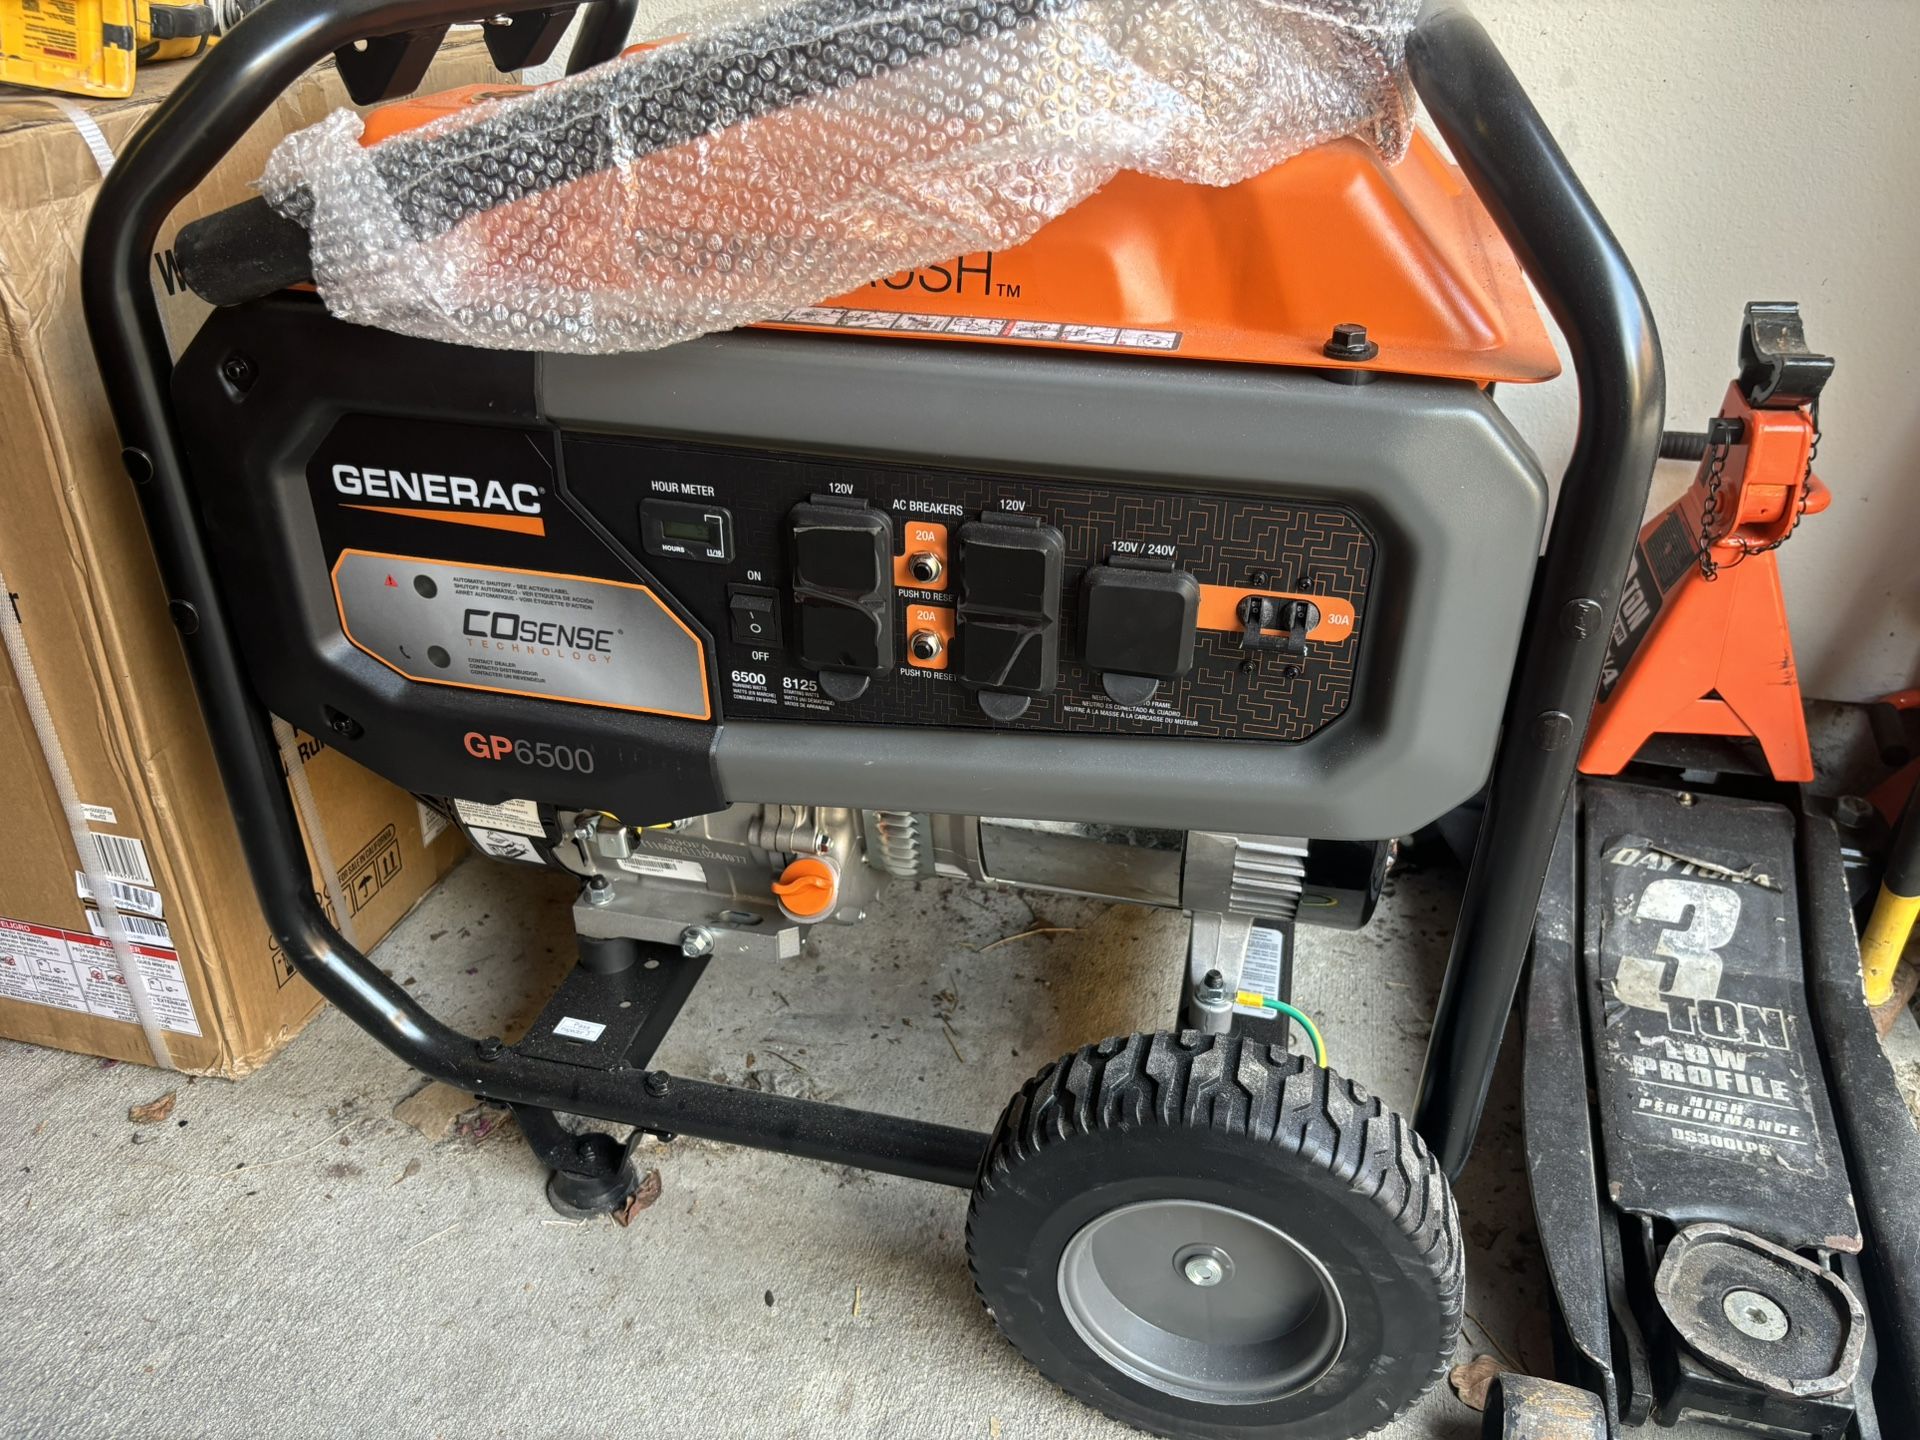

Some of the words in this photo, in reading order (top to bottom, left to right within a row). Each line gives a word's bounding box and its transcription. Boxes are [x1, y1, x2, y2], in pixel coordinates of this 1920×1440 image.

[651, 480, 679, 493] HOUR
[681, 483, 715, 497] METER
[829, 482, 853, 494] 120V
[893, 499, 907, 511] AC
[909, 500, 963, 516] BREAKERS
[1000, 499, 1026, 512] 120V
[915, 530, 935, 542] 20A
[662, 543, 685, 553] HOURS
[1111, 540, 1138, 554] 120V
[1147, 543, 1176, 557] 240V
[747, 570, 761, 581] ON
[898, 589, 919, 598] PUSH
[921, 591, 931, 599] TO
[917, 610, 936, 621] 20A
[1327, 613, 1350, 625] 30A
[467, 638, 612, 664] TECHNOLOGY
[751, 650, 770, 661] OFF
[731, 670, 766, 685] 6500
[900, 668, 920, 678] PUSH
[922, 670, 932, 679] TO
[782, 677, 818, 691] 8125
[1082, 700, 1104, 708] NEUTRO
[1064, 705, 1085, 713] NEUTRE
[1100, 710, 1120, 718] MASSE
[1134, 713, 1163, 722] CARCASSE
[1174, 718, 1199, 727] MOTEUR
[463, 731, 595, 774] GP6500
[364, 830, 393, 862] CALIFORNIA
[1615, 879, 1741, 1013] 3
[1659, 992, 1790, 1051] TON
[1664, 1039, 1747, 1072] LOW
[1632, 1054, 1791, 1101] PROFILE
[1689, 1095, 1744, 1115] HIGH
[1638, 1098, 1800, 1137] PERFORMANCE
